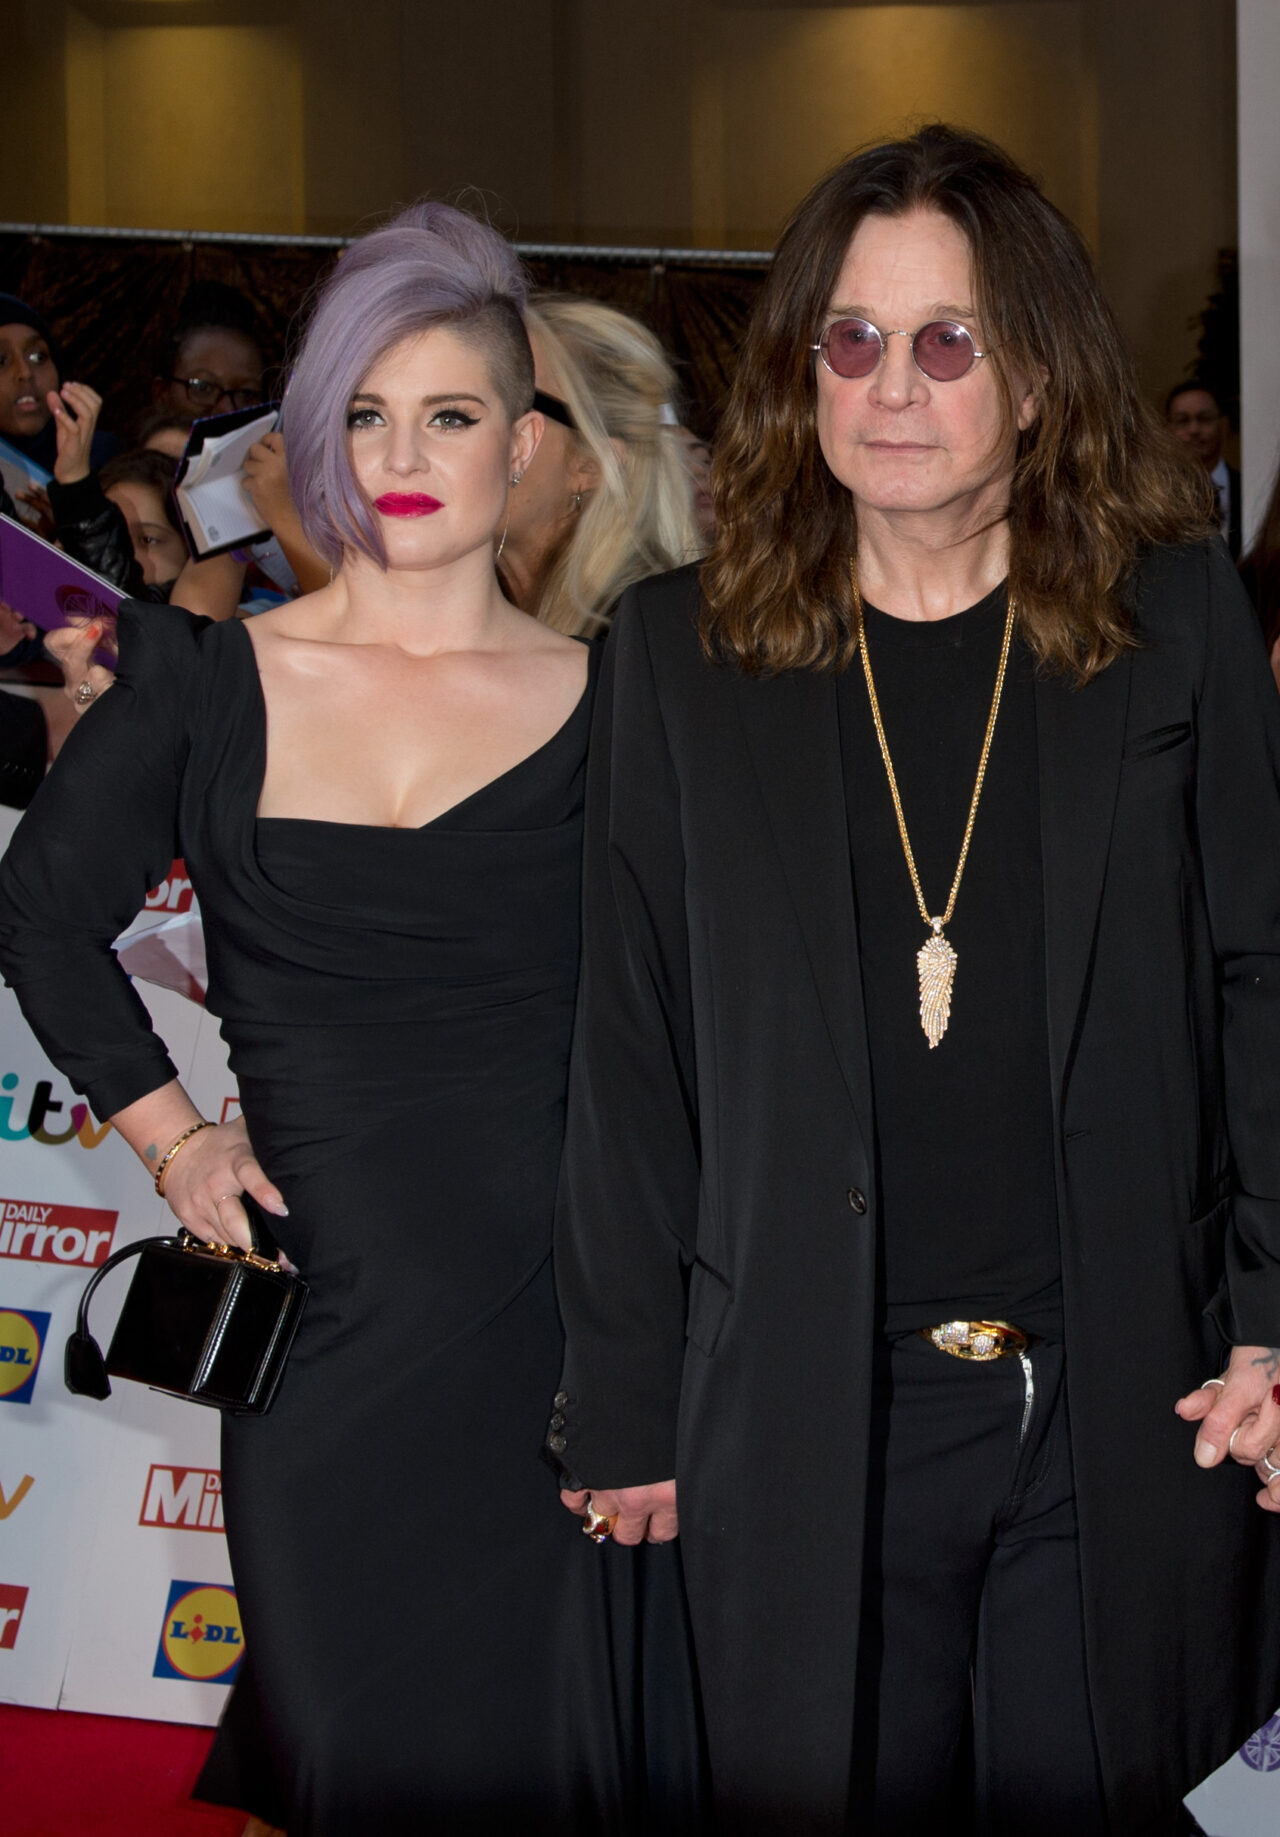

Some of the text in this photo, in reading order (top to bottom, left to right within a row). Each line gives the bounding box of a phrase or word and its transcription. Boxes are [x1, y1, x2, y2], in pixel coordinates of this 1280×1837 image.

[0, 1072, 112, 1150] itv
[0, 1203, 112, 1264] irror
[5, 1203, 53, 1224] DAILY
[0, 1345, 32, 1366] DL
